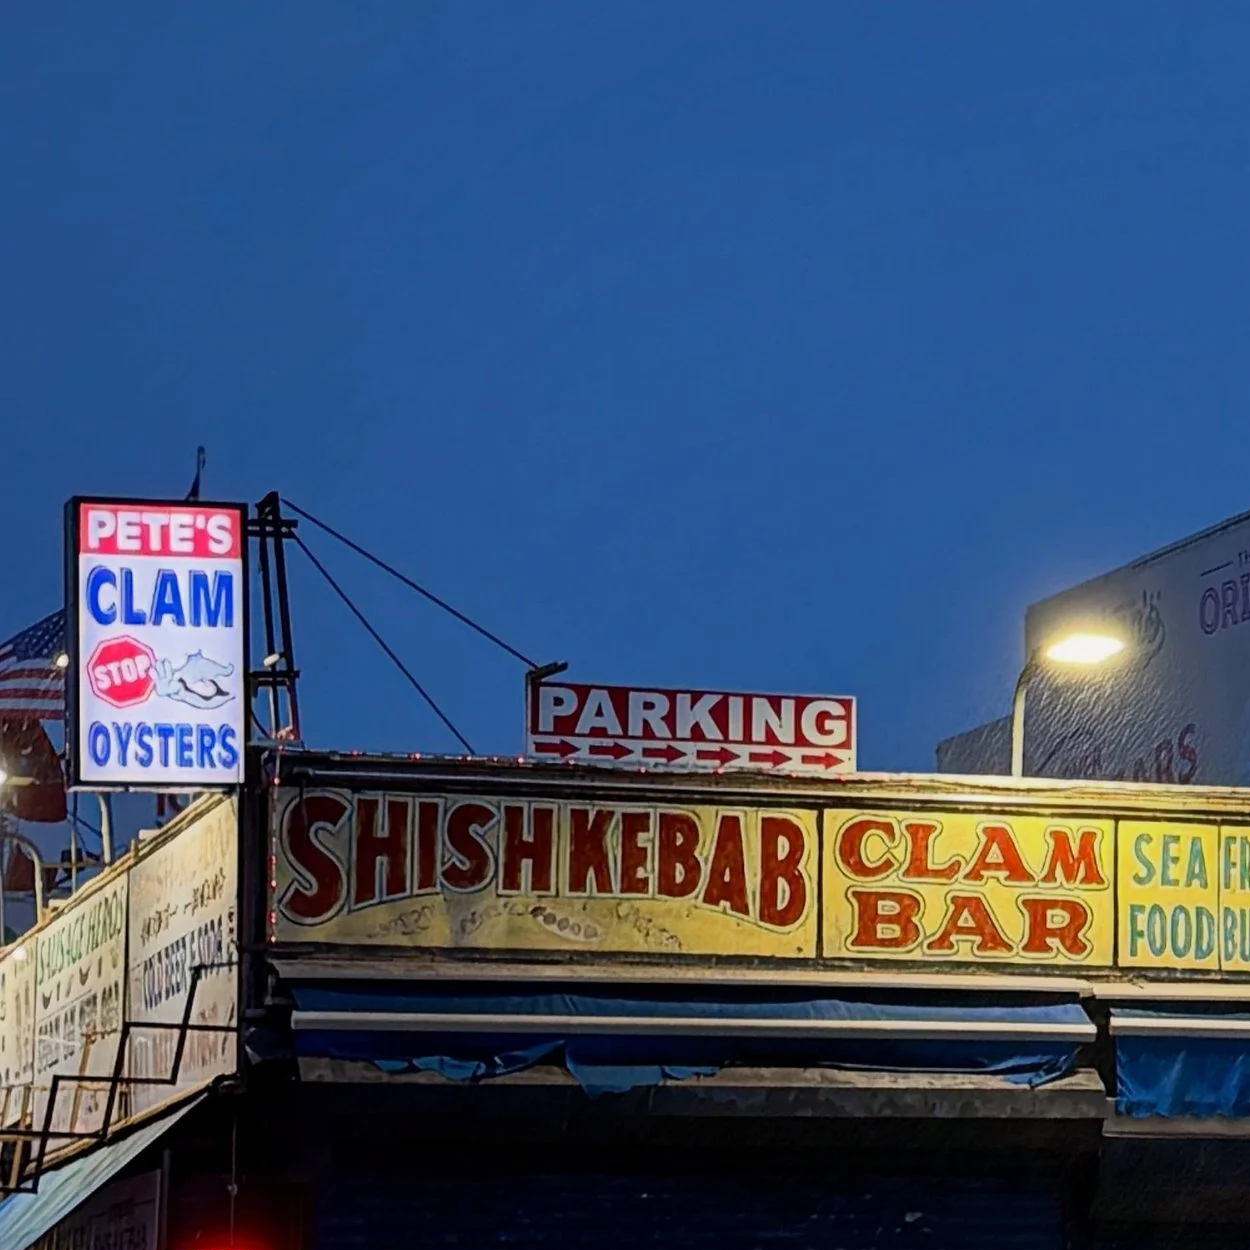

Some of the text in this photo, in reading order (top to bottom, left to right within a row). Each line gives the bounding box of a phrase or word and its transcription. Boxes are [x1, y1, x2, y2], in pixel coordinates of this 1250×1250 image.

[88, 511, 235, 553] PETE'S
[86, 565, 234, 628] CLAM
[94, 655, 150, 691] STOP
[538, 688, 848, 745] PARKING
[88, 721, 239, 769] OYSTERS
[839, 819, 1105, 886] CLAM
[1133, 833, 1208, 889] SEA
[850, 891, 1089, 956] BAR
[1130, 904, 1215, 960] FOOD
